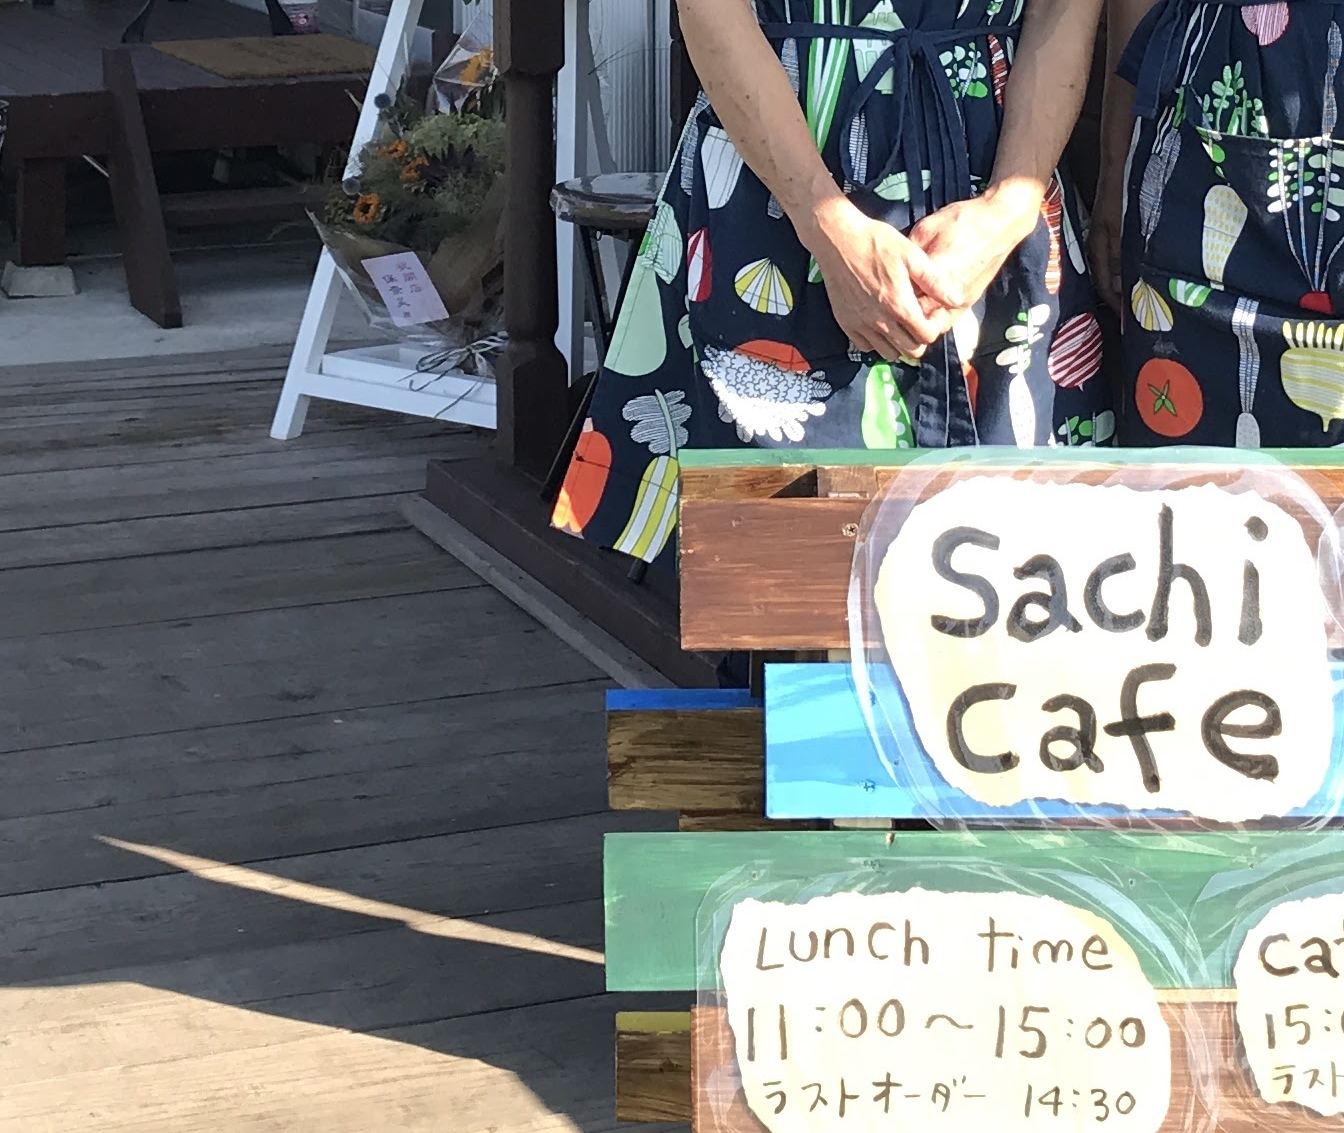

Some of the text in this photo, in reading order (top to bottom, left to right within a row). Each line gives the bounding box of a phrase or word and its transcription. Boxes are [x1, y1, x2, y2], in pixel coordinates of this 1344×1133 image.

[930, 502, 1269, 648] Sachi
[976, 915, 1114, 973] time
[761, 1070, 1137, 1123] ラストオーダー 14:30
